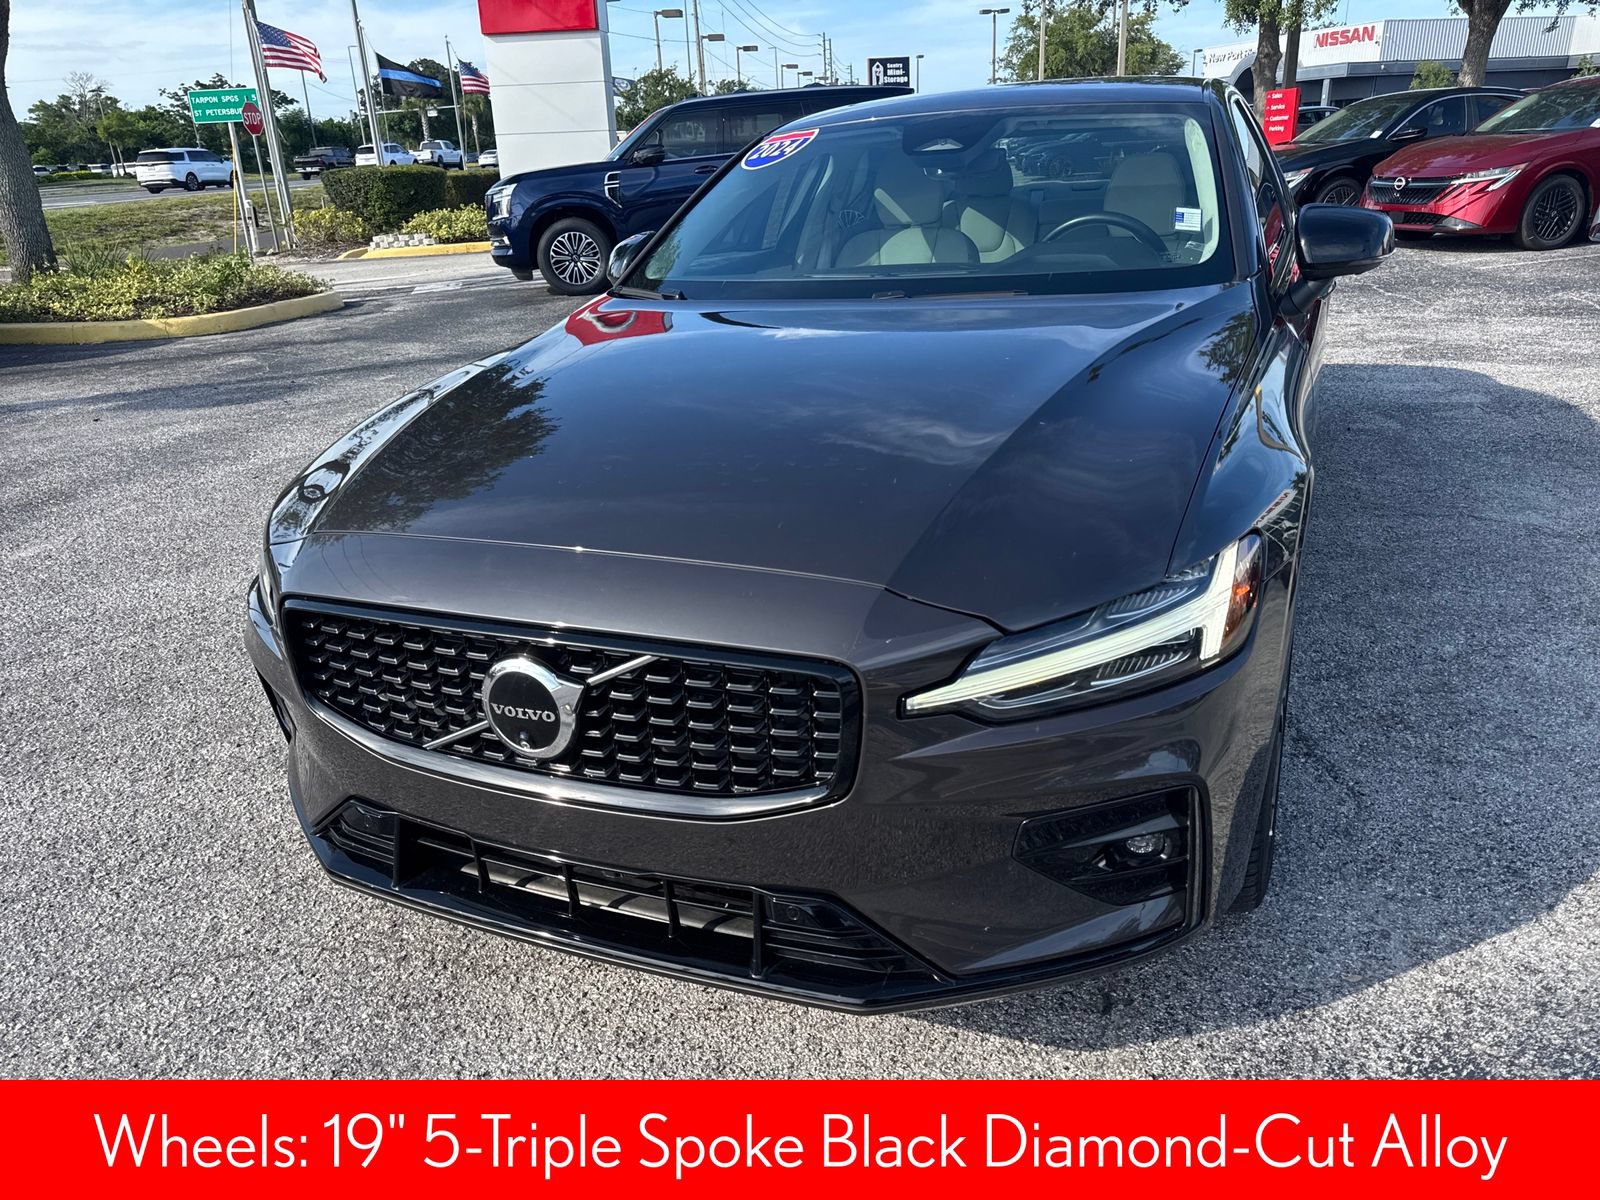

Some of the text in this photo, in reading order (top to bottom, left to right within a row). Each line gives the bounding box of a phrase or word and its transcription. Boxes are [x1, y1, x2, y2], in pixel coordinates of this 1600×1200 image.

[1314, 25, 1375, 48] NISSAN
[191, 96, 218, 104] TARPON
[244, 112, 261, 125] STOP
[747, 139, 804, 160] 2024
[490, 702, 555, 722] VOLVO
